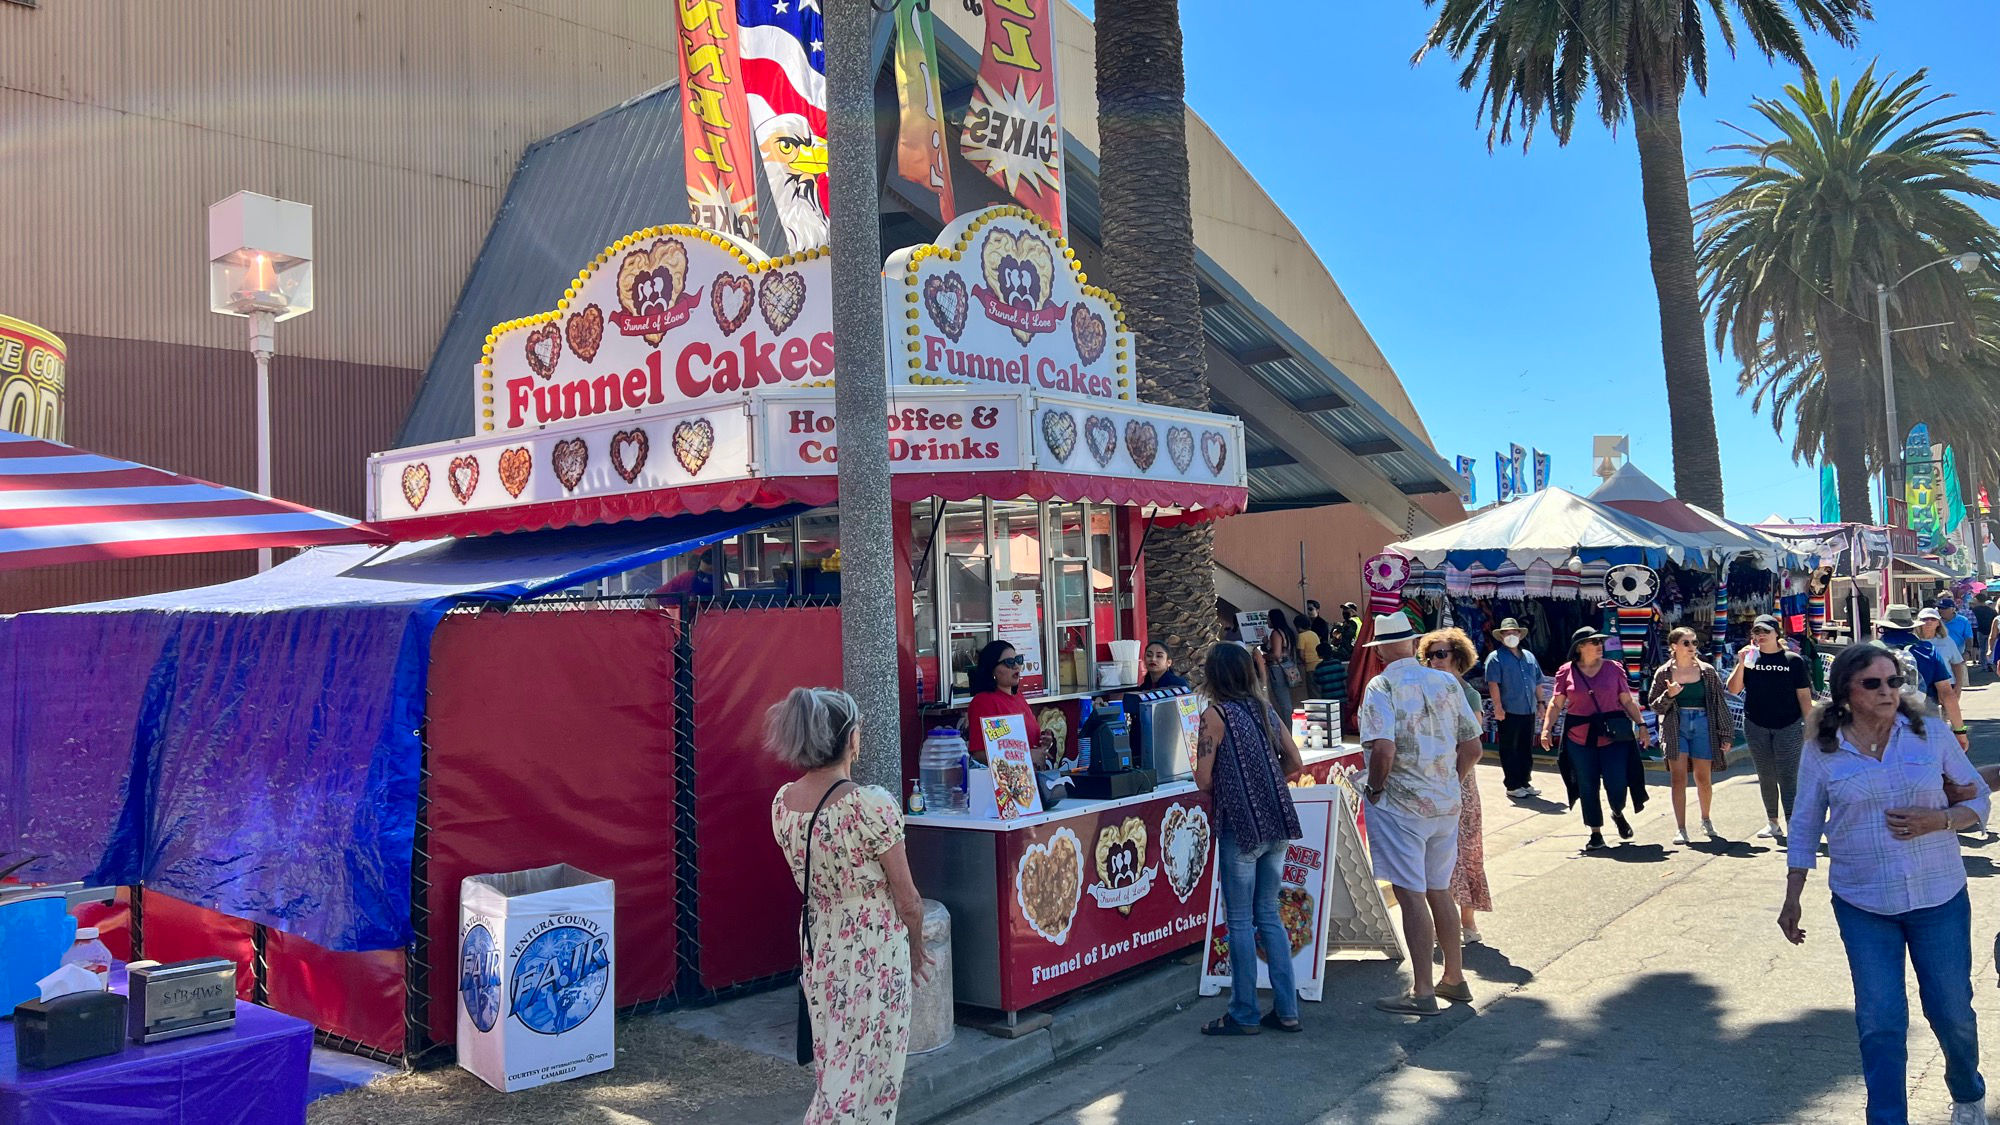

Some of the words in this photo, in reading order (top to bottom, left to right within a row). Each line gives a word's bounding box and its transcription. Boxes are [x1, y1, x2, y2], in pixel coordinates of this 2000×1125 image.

[623, 317, 649, 331] Funnel
[652, 315, 660, 331] of
[663, 311, 684, 325] Love
[989, 301, 1018, 323] Funnel
[1020, 316, 1029, 329] of
[1032, 316, 1051, 327] Love
[506, 350, 665, 428] Funnel
[675, 331, 834, 398] Cakes
[924, 335, 1030, 385] Funnel
[1036, 356, 1112, 398] Cakes
[788, 410, 836, 433] Ho
[887, 408, 963, 431] offee
[971, 405, 999, 429] &
[799, 440, 838, 463] Co
[888, 436, 1000, 461] Drinks
[1912, 464, 1933, 548] DRINKS
[1752, 664, 1790, 672] ELOTON
[1285, 844, 1322, 870] NEL
[1281, 864, 1308, 886] KE
[1100, 890, 1121, 903] Funnel
[1123, 889, 1130, 902] of
[1133, 885, 1147, 897] Love
[510, 919, 554, 959] VENTURA
[557, 915, 601, 933] COUNTY
[1032, 952, 1081, 985] Funnel
[1084, 947, 1098, 966] of
[1101, 941, 1129, 960] Love
[1133, 921, 1173, 949] Funnel
[1175, 912, 1207, 933] Cakes
[459, 949, 501, 991] FAIR
[507, 932, 611, 1018] FAIR
[508, 1069, 541, 1081] COURTESY
[551, 1059, 586, 1069] INTERNATIONAL
[541, 1066, 576, 1080] CAMARILLO
